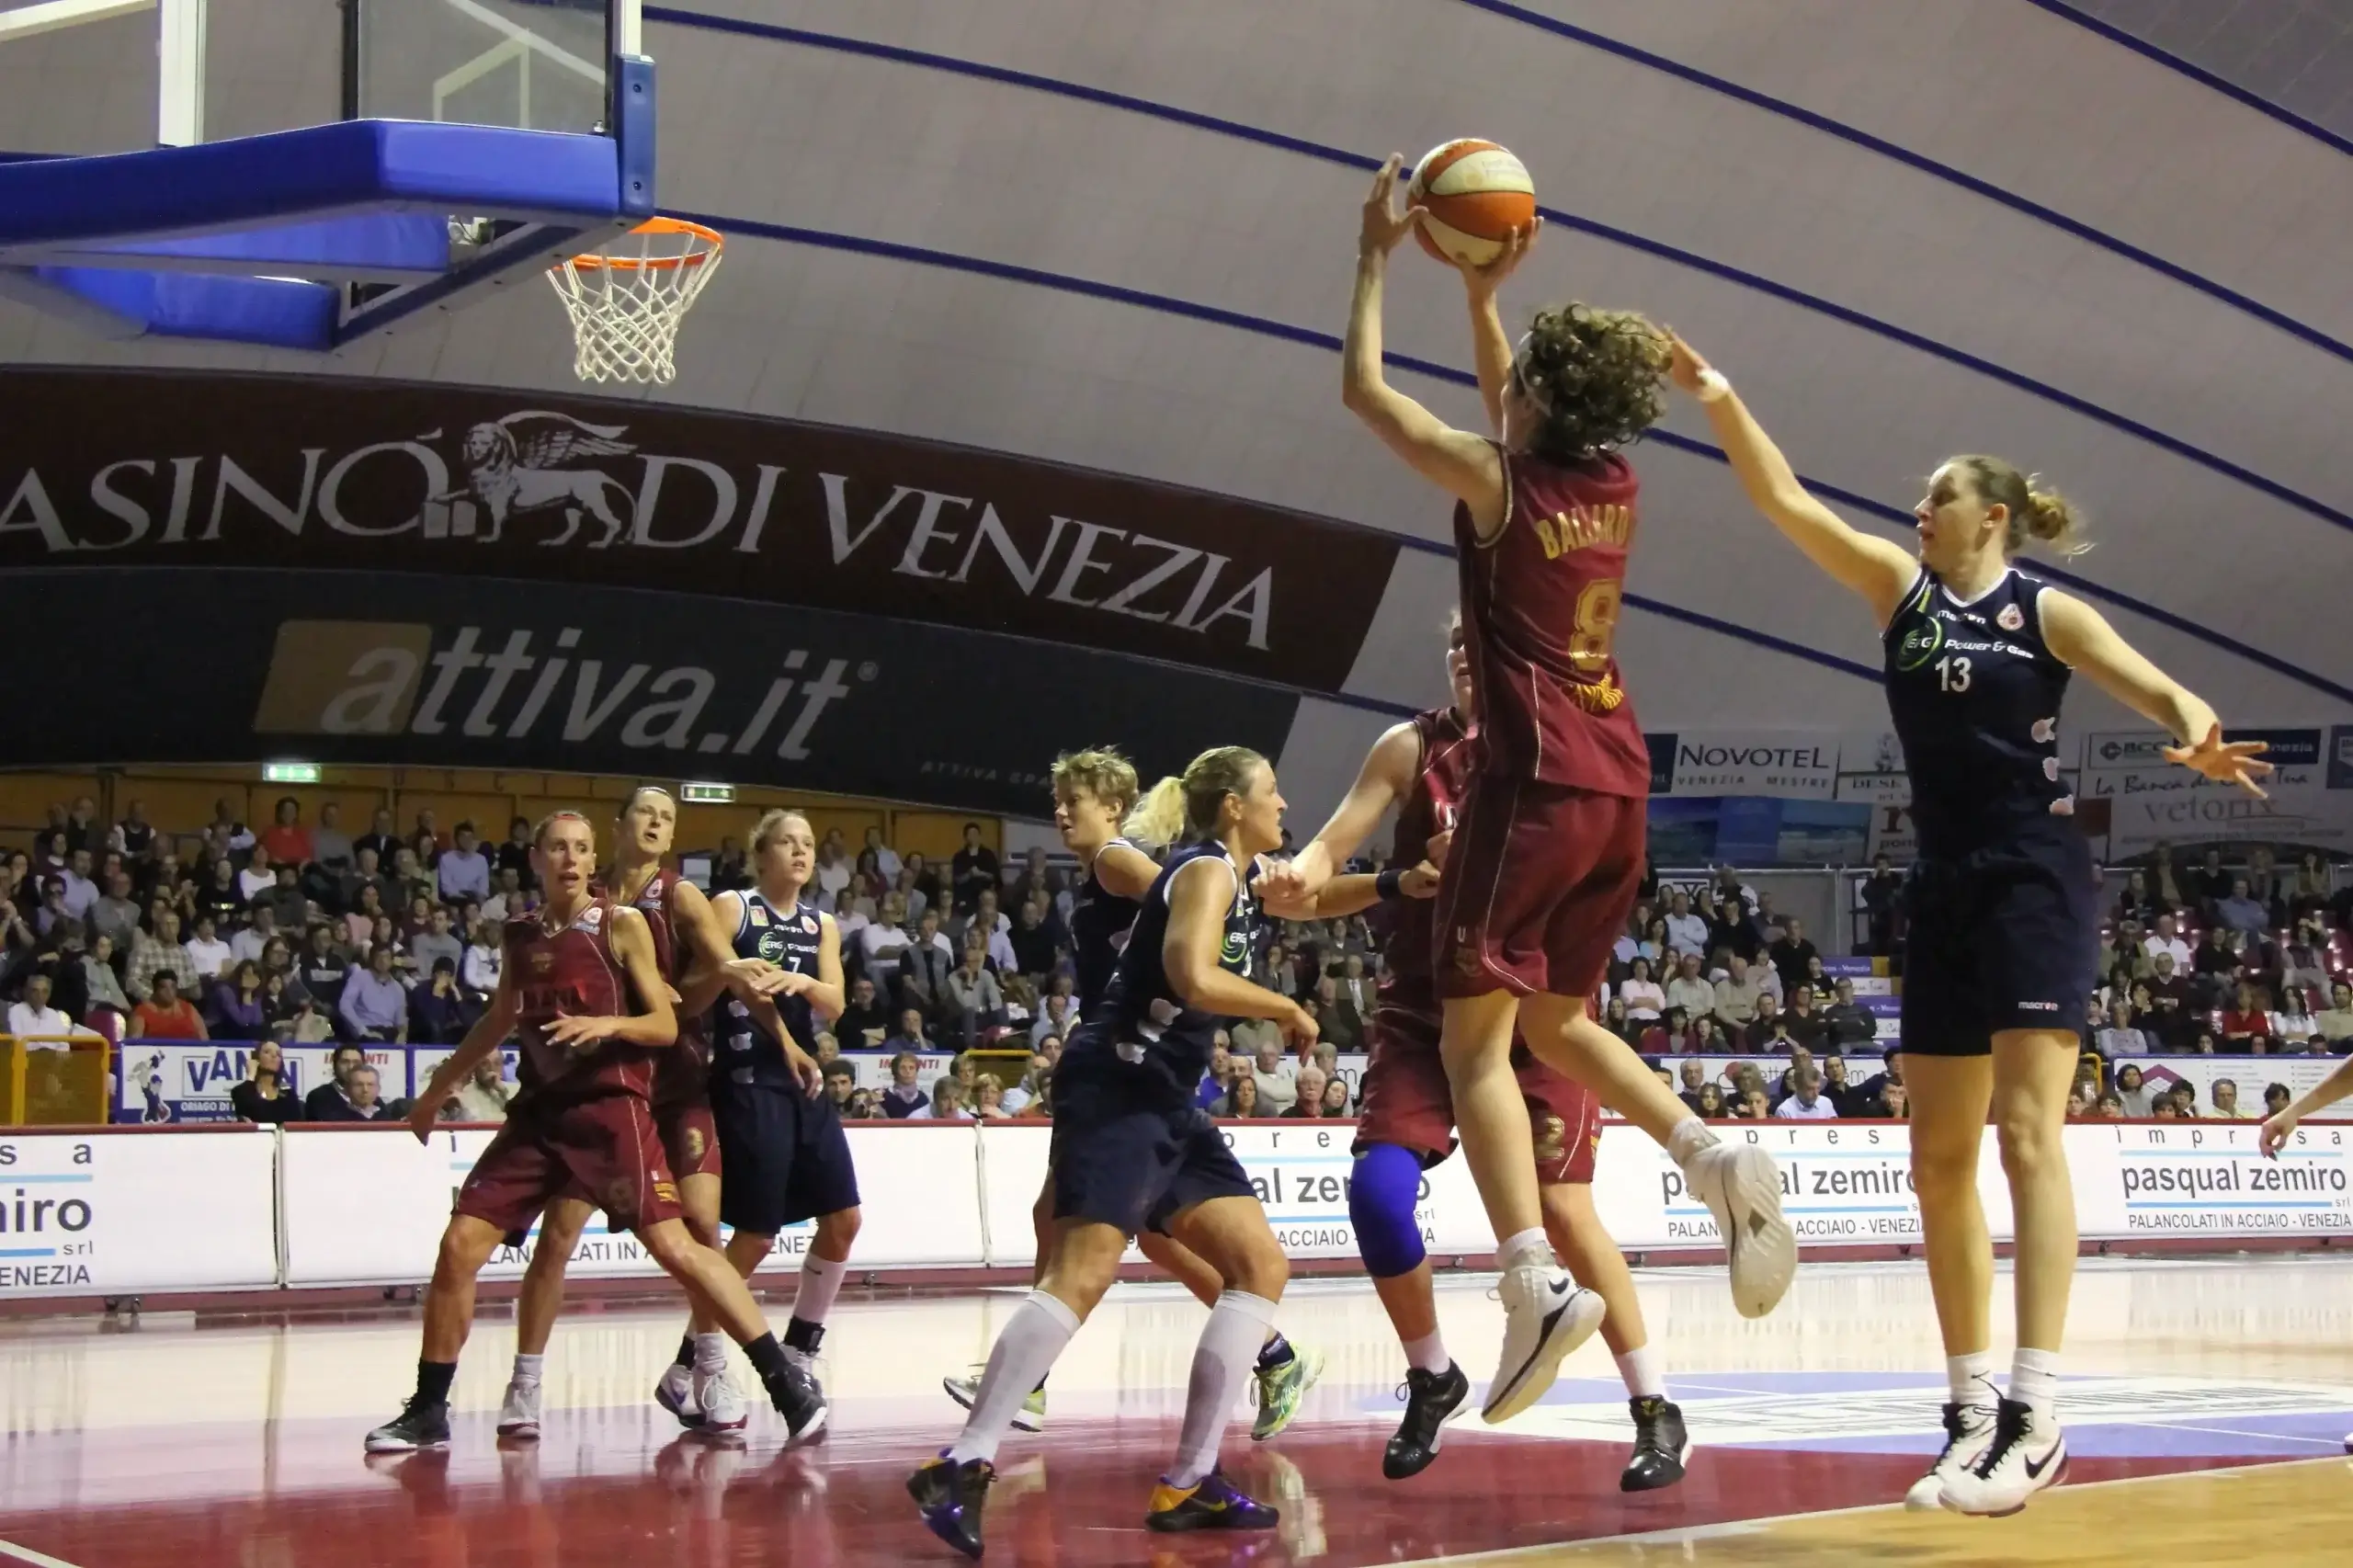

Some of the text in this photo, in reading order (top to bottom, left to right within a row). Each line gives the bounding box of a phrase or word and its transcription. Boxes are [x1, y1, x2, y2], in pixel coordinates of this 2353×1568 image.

[632, 454, 787, 553] DI
[817, 472, 1275, 651] VENEZIA
[1935, 655, 1972, 692] 13
[320, 627, 850, 762] attiva.it
[1679, 744, 1830, 768] NOVOTEL
[2121, 1160, 2346, 1199] pasqual zemiro
[1795, 1221, 1857, 1235] ACCIAIO
[2129, 1213, 2218, 1229] PALANCOLATI
[2221, 1213, 2234, 1229] IN
[2237, 1213, 2289, 1228] ACCIAIO
[2299, 1212, 2352, 1228] VENEZIA
[63, 1240, 94, 1256] srl
[1277, 1229, 1348, 1246] ACCIAIO
